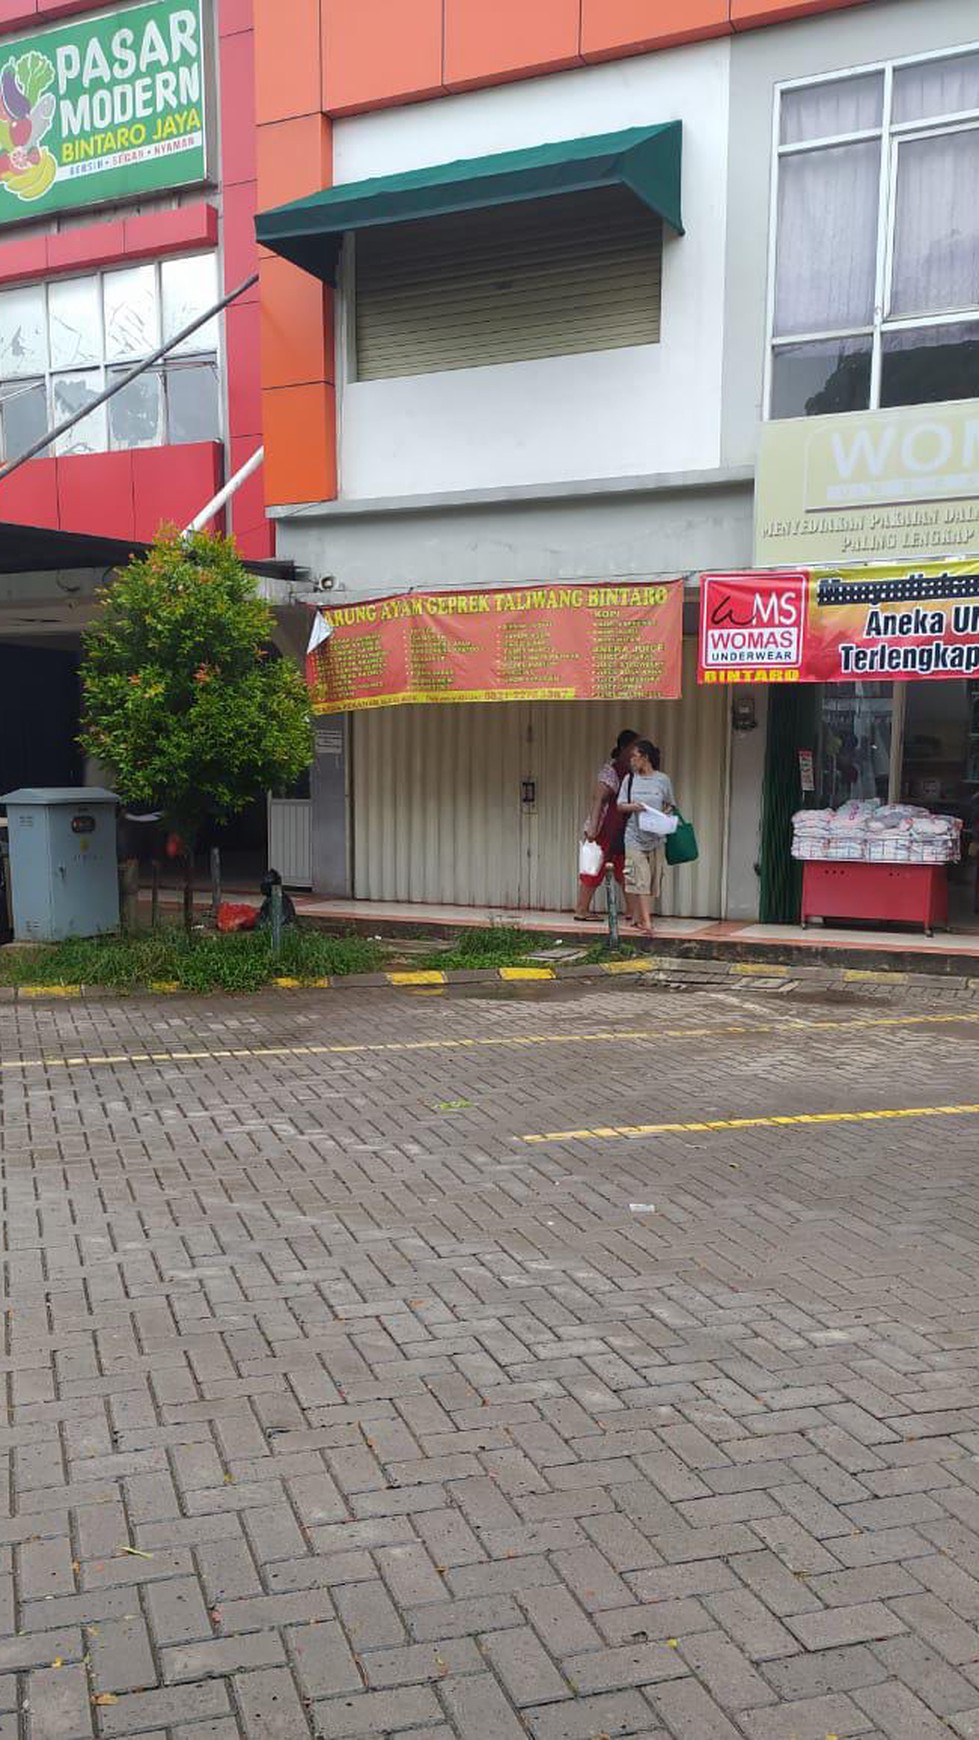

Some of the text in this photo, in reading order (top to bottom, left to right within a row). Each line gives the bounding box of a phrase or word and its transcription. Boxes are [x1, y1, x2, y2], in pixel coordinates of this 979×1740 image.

[56, 9, 198, 95] PASAR
[59, 62, 200, 138] MODERN
[61, 108, 201, 163] BINTARO JAYA
[323, 586, 669, 627] ARUNG AYAM GEPREK TALIWANG BINTARO
[865, 607, 944, 637] Aneka
[711, 630, 793, 650] WOMAS
[711, 651, 792, 662] UNDERWEAR
[840, 641, 979, 674] Terlengkap
[704, 669, 800, 683] BINTARO
